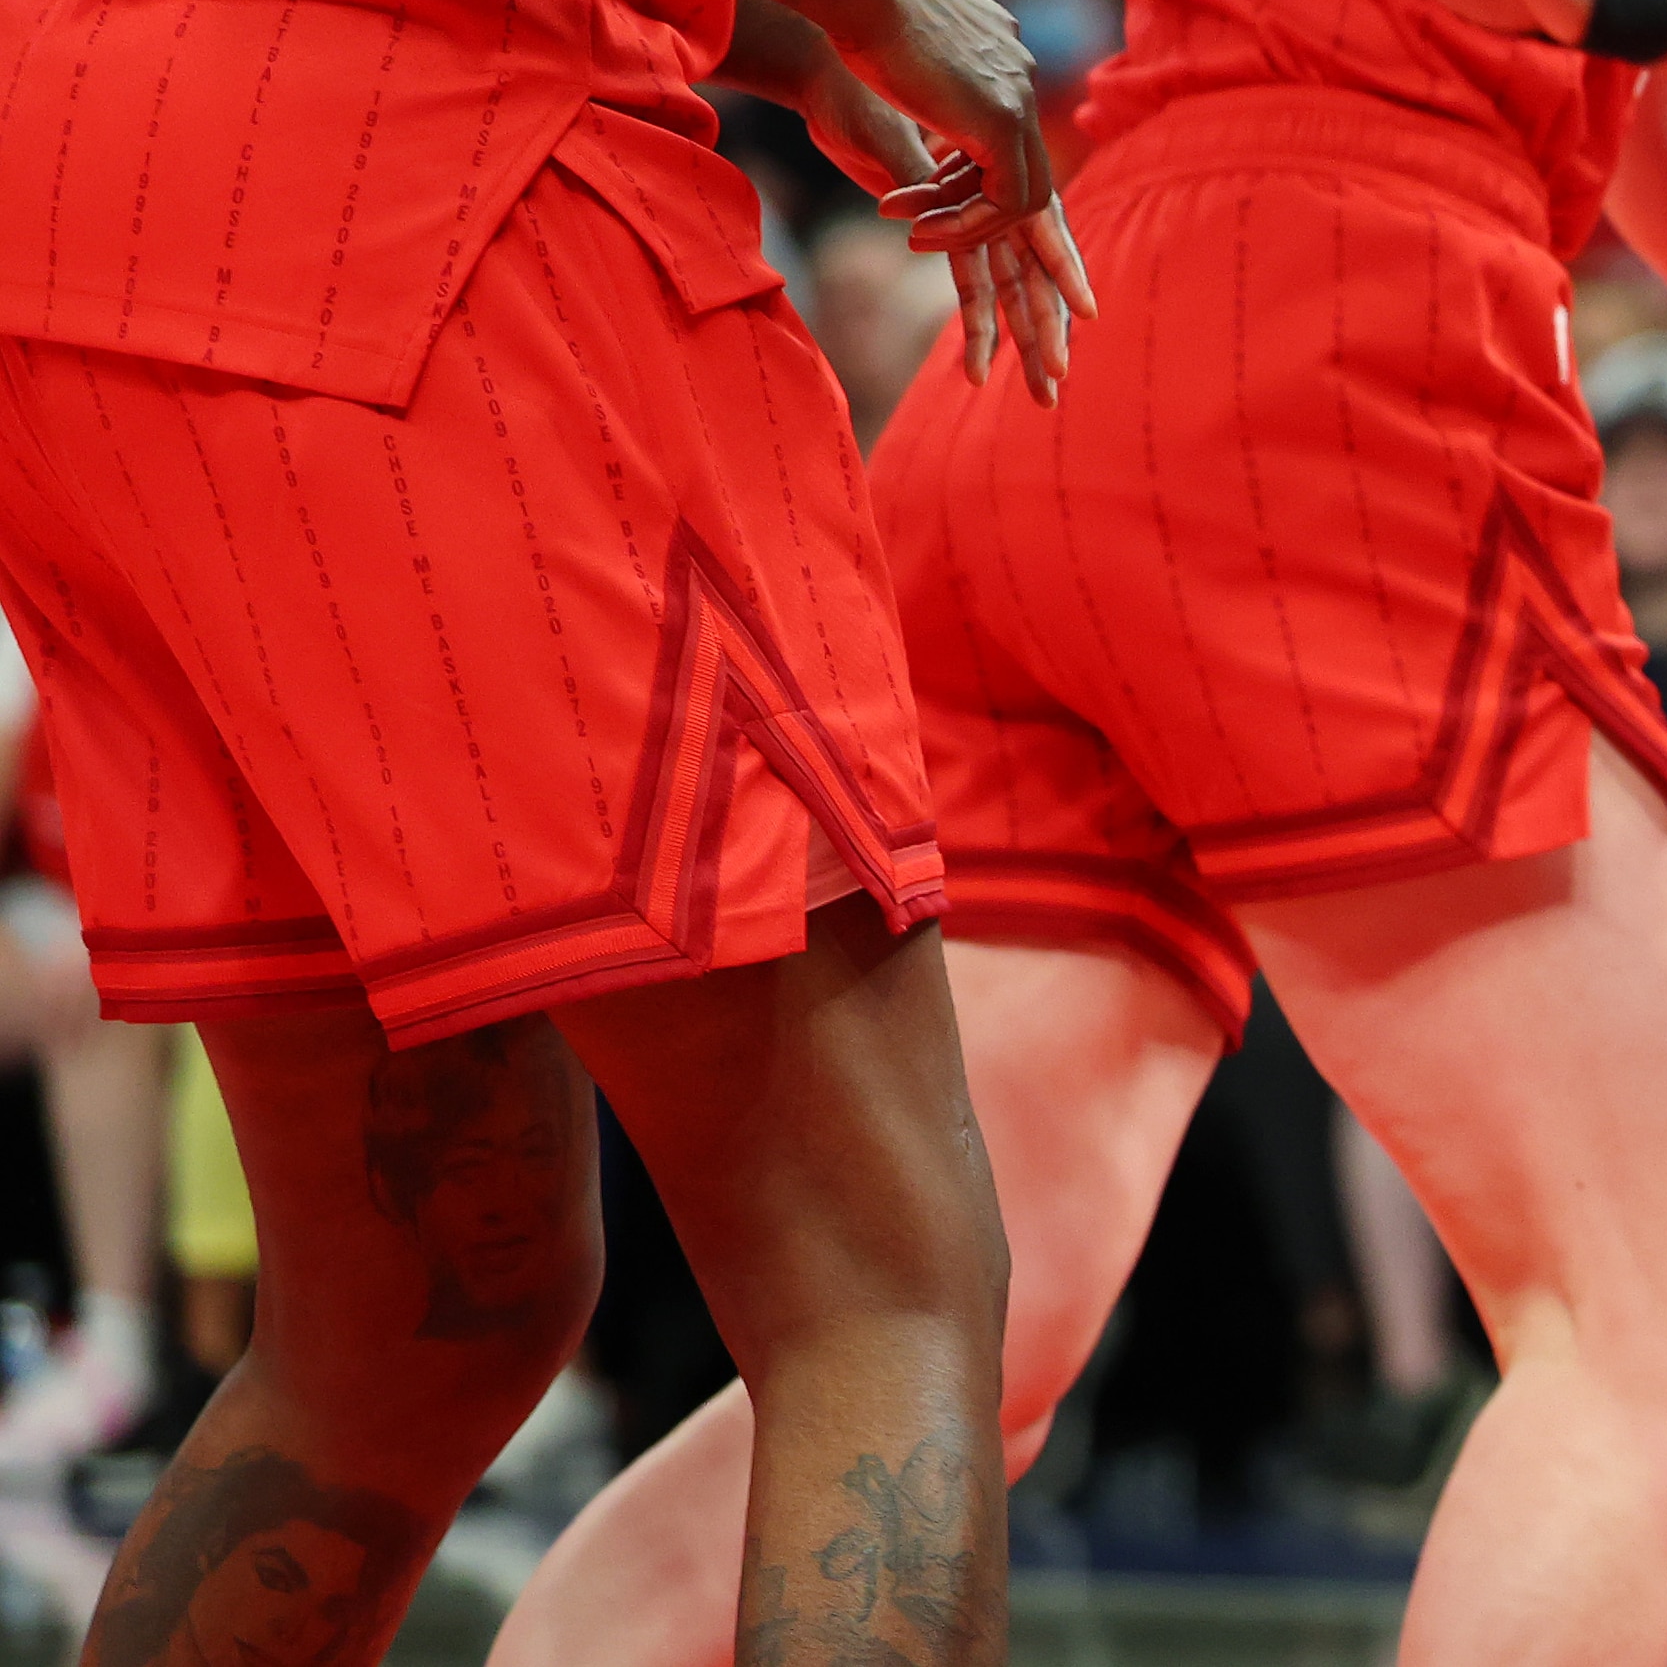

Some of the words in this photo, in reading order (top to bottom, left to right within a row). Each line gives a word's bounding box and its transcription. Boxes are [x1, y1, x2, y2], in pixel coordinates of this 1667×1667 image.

[352, 89, 382, 172] 1999
[471, 69, 512, 169] CHOSE
[223, 142, 254, 251] CHOSE
[330, 182, 361, 268] 2009
[455, 183, 478, 222] ME
[215, 265, 233, 307] ME
[309, 284, 339, 371] 2012
[604, 459, 625, 502] ME
[270, 402, 298, 488] 1999
[297, 506, 332, 591] 2009
[328, 600, 363, 686] 2012
[362, 701, 394, 786] 2020
[382, 432, 420, 539] CHOSE
[411, 553, 435, 596] ME
[429, 611, 498, 824] BASKETBALL
[474, 355, 508, 439] 2009
[505, 455, 538, 541] 2012
[530, 551, 564, 636] 2020
[559, 653, 588, 739] 1972
[586, 754, 615, 839] 1999
[144, 829, 159, 913] 2009
